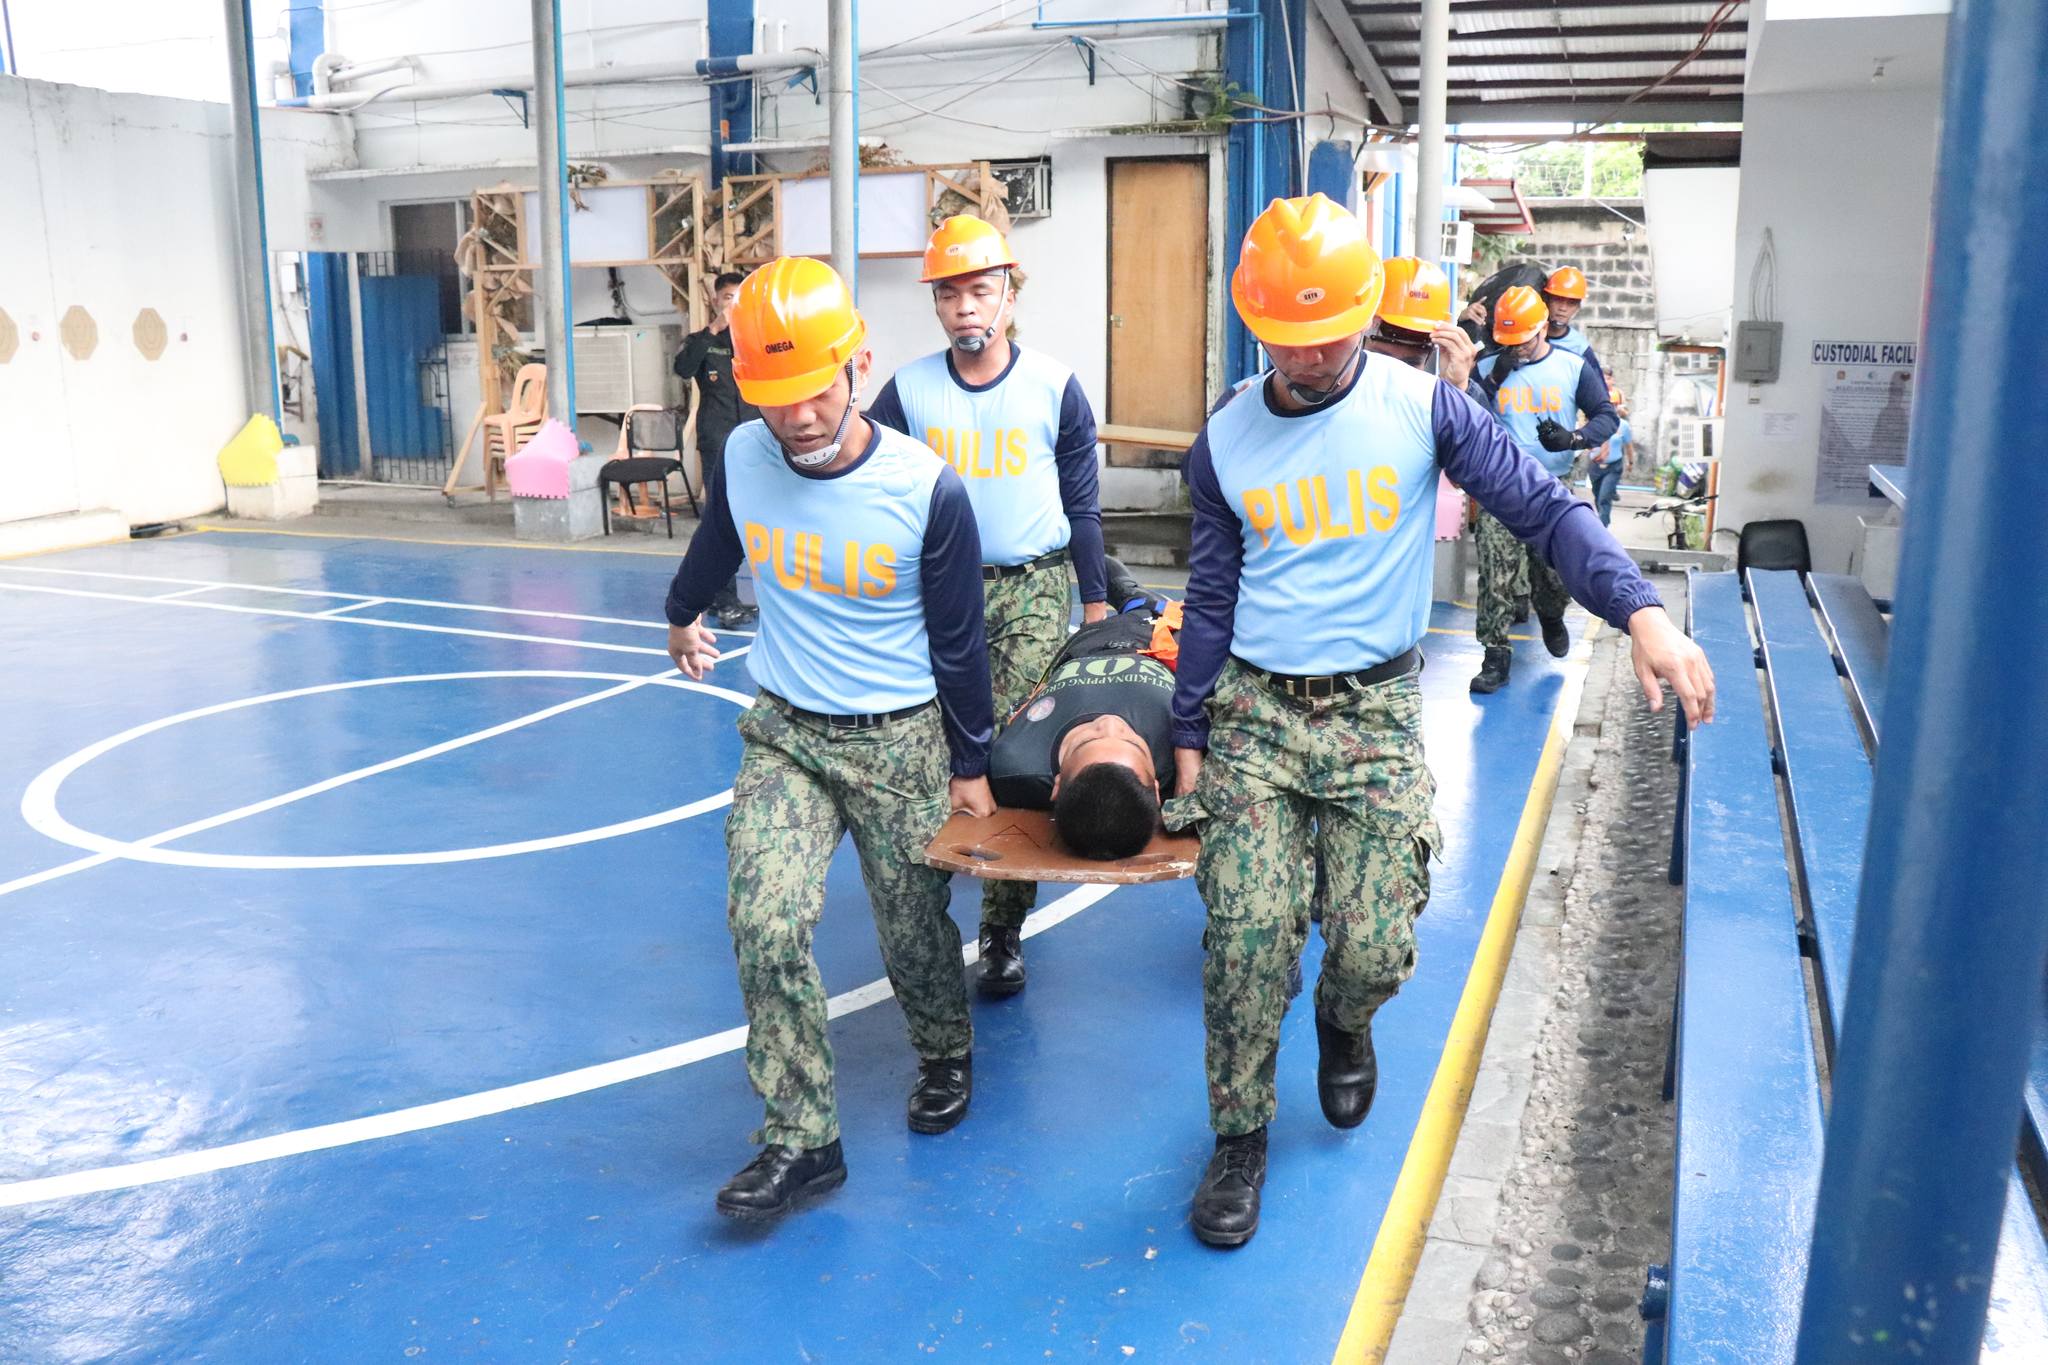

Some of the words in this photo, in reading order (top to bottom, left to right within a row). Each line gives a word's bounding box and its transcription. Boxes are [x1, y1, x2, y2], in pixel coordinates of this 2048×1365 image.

[765, 340, 795, 354] OMEGA
[1814, 343, 1878, 363] CUSTODIAL
[1498, 386, 1561, 414] PULIS
[926, 426, 1028, 478] PULIS
[1241, 464, 1401, 549] PULIS
[744, 520, 897, 599] PULIS
[1067, 672, 1176, 693] NTI-KIDNAPPING
